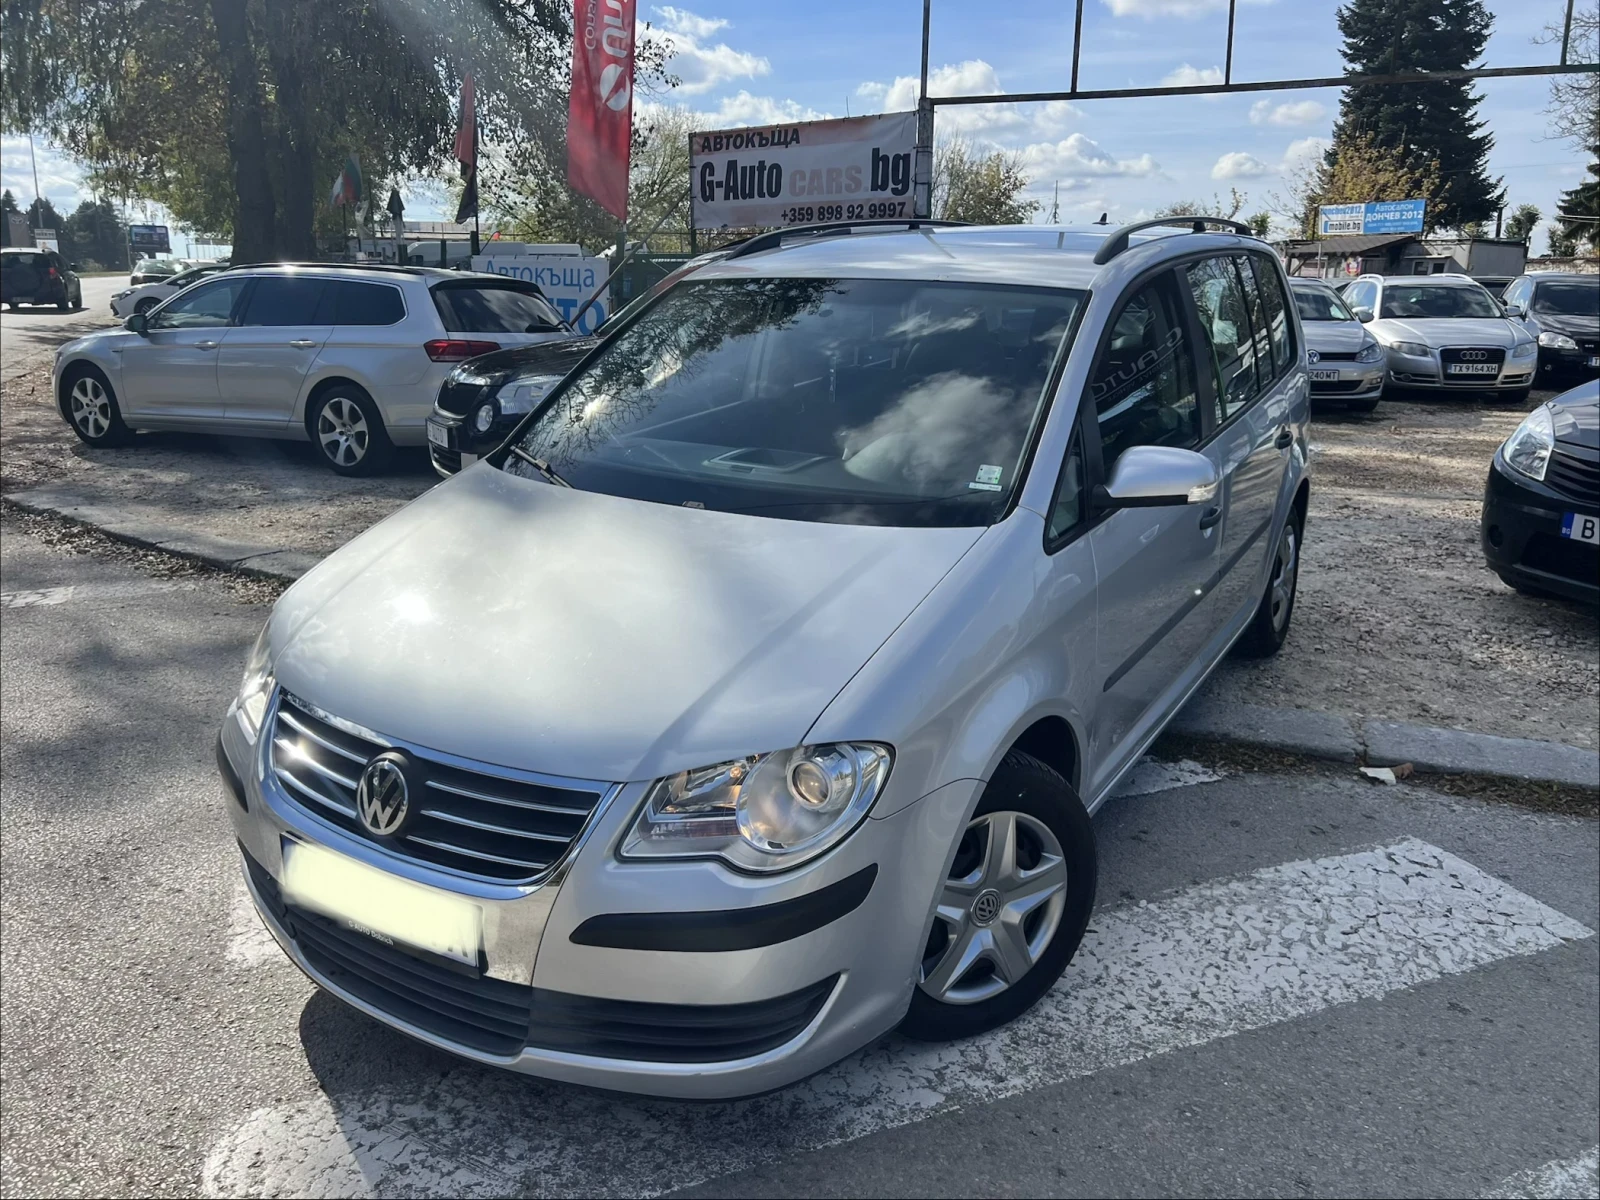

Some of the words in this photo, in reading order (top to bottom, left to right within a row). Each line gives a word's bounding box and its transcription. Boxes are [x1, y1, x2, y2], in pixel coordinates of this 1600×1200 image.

[701, 128, 800, 152] АВТОКЪЩА
[700, 159, 783, 203] G-Auto
[781, 206, 814, 223] +359
[817, 205, 843, 221] 898
[847, 204, 864, 220] 92
[868, 202, 907, 219] 9997
[1365, 212, 1401, 223] ДОНЧЕВ
[1402, 210, 1424, 219] 2012
[485, 259, 596, 293] Автокъща
[1453, 364, 1464, 372] TX
[1465, 364, 1485, 372] 9164
[1486, 365, 1497, 373] XH
[1581, 518, 1596, 540] B
